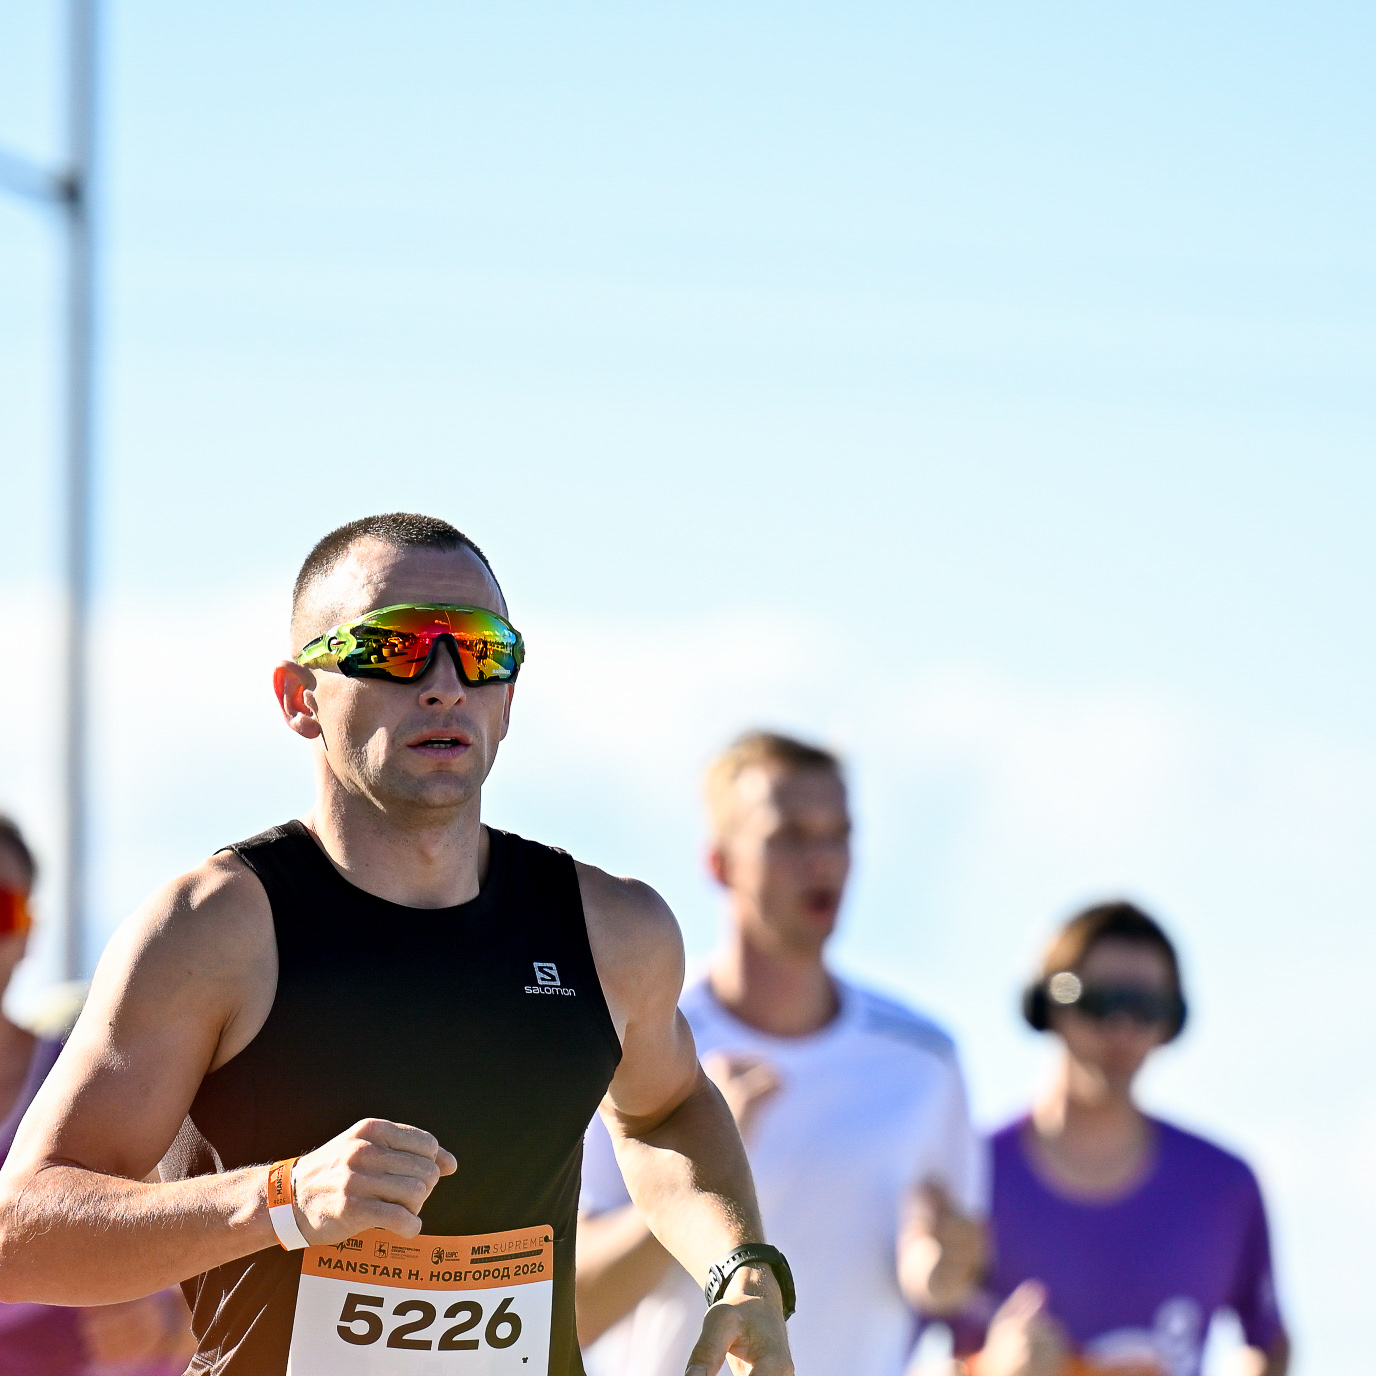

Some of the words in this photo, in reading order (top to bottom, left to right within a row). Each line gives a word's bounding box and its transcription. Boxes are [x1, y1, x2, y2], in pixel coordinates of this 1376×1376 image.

[470, 1245, 490, 1256] MIR
[492, 1236, 544, 1254] SUPREME
[317, 1256, 402, 1279] MANSTAR
[429, 1266, 511, 1282] НОВГОРОД
[513, 1261, 545, 1277] 2026
[336, 1292, 522, 1351] 5226
